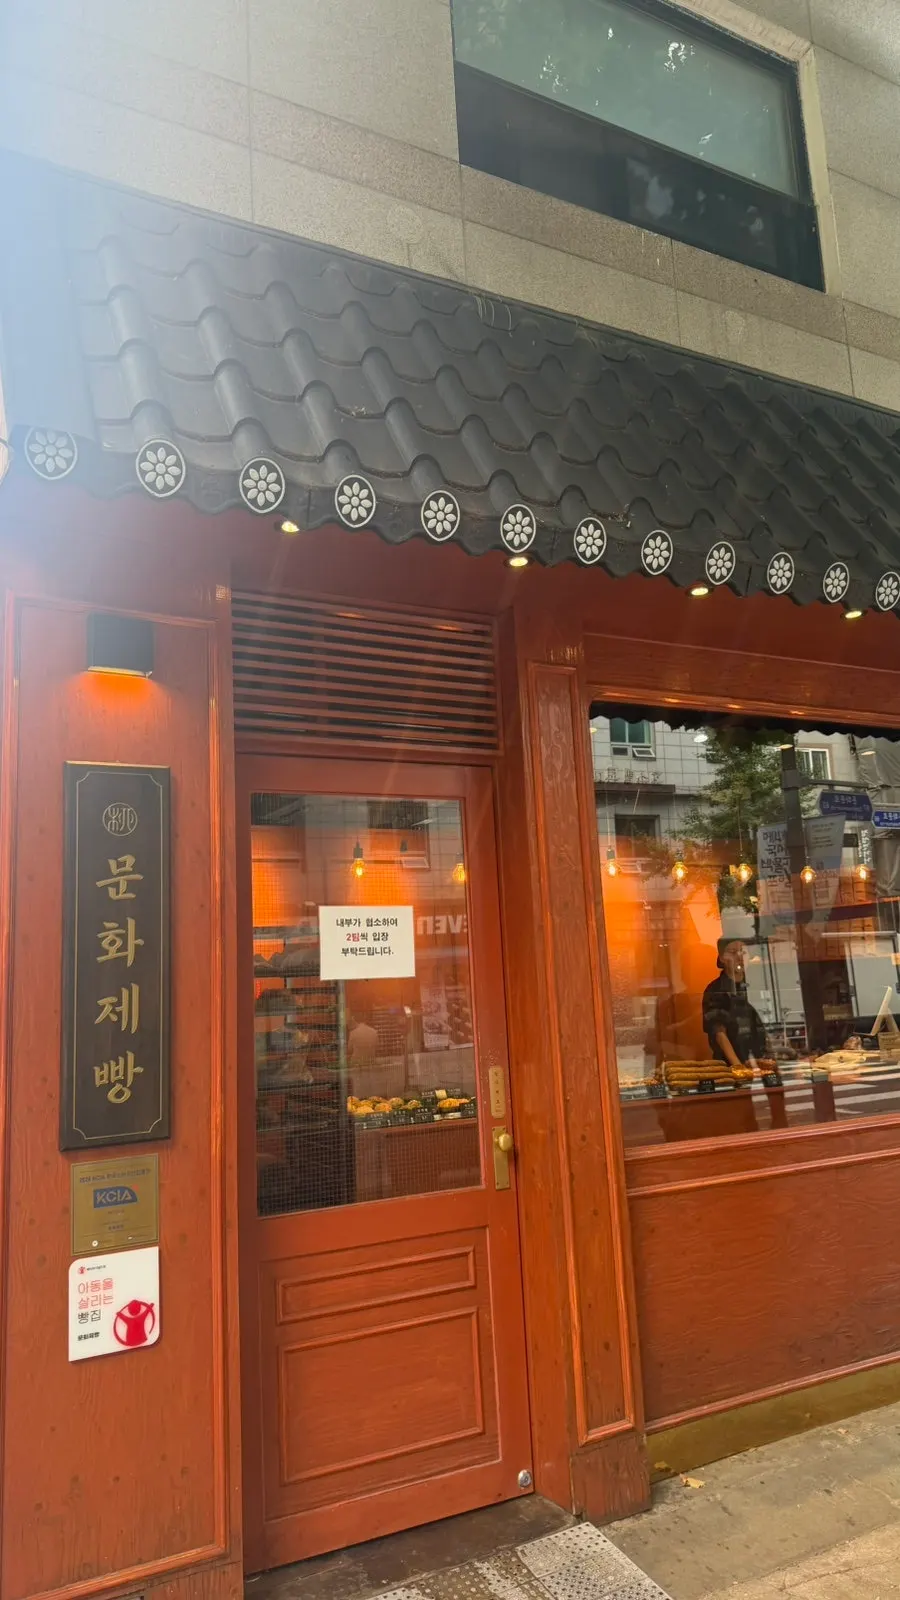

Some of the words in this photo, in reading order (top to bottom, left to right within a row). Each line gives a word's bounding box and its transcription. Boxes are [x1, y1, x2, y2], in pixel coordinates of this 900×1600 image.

[336, 918, 361, 928] 내부가
[366, 917, 398, 928] 협소하여
[346, 932, 368, 942] 2팀씩
[372, 932, 389, 942] 입장
[341, 946, 394, 957] 부탁드립니다.
[93, 853, 145, 1105] 문화제빵
[96, 1188, 133, 1204] KCIA
[78, 1293, 114, 1310] 살리는
[78, 1309, 102, 1324] 빵집
